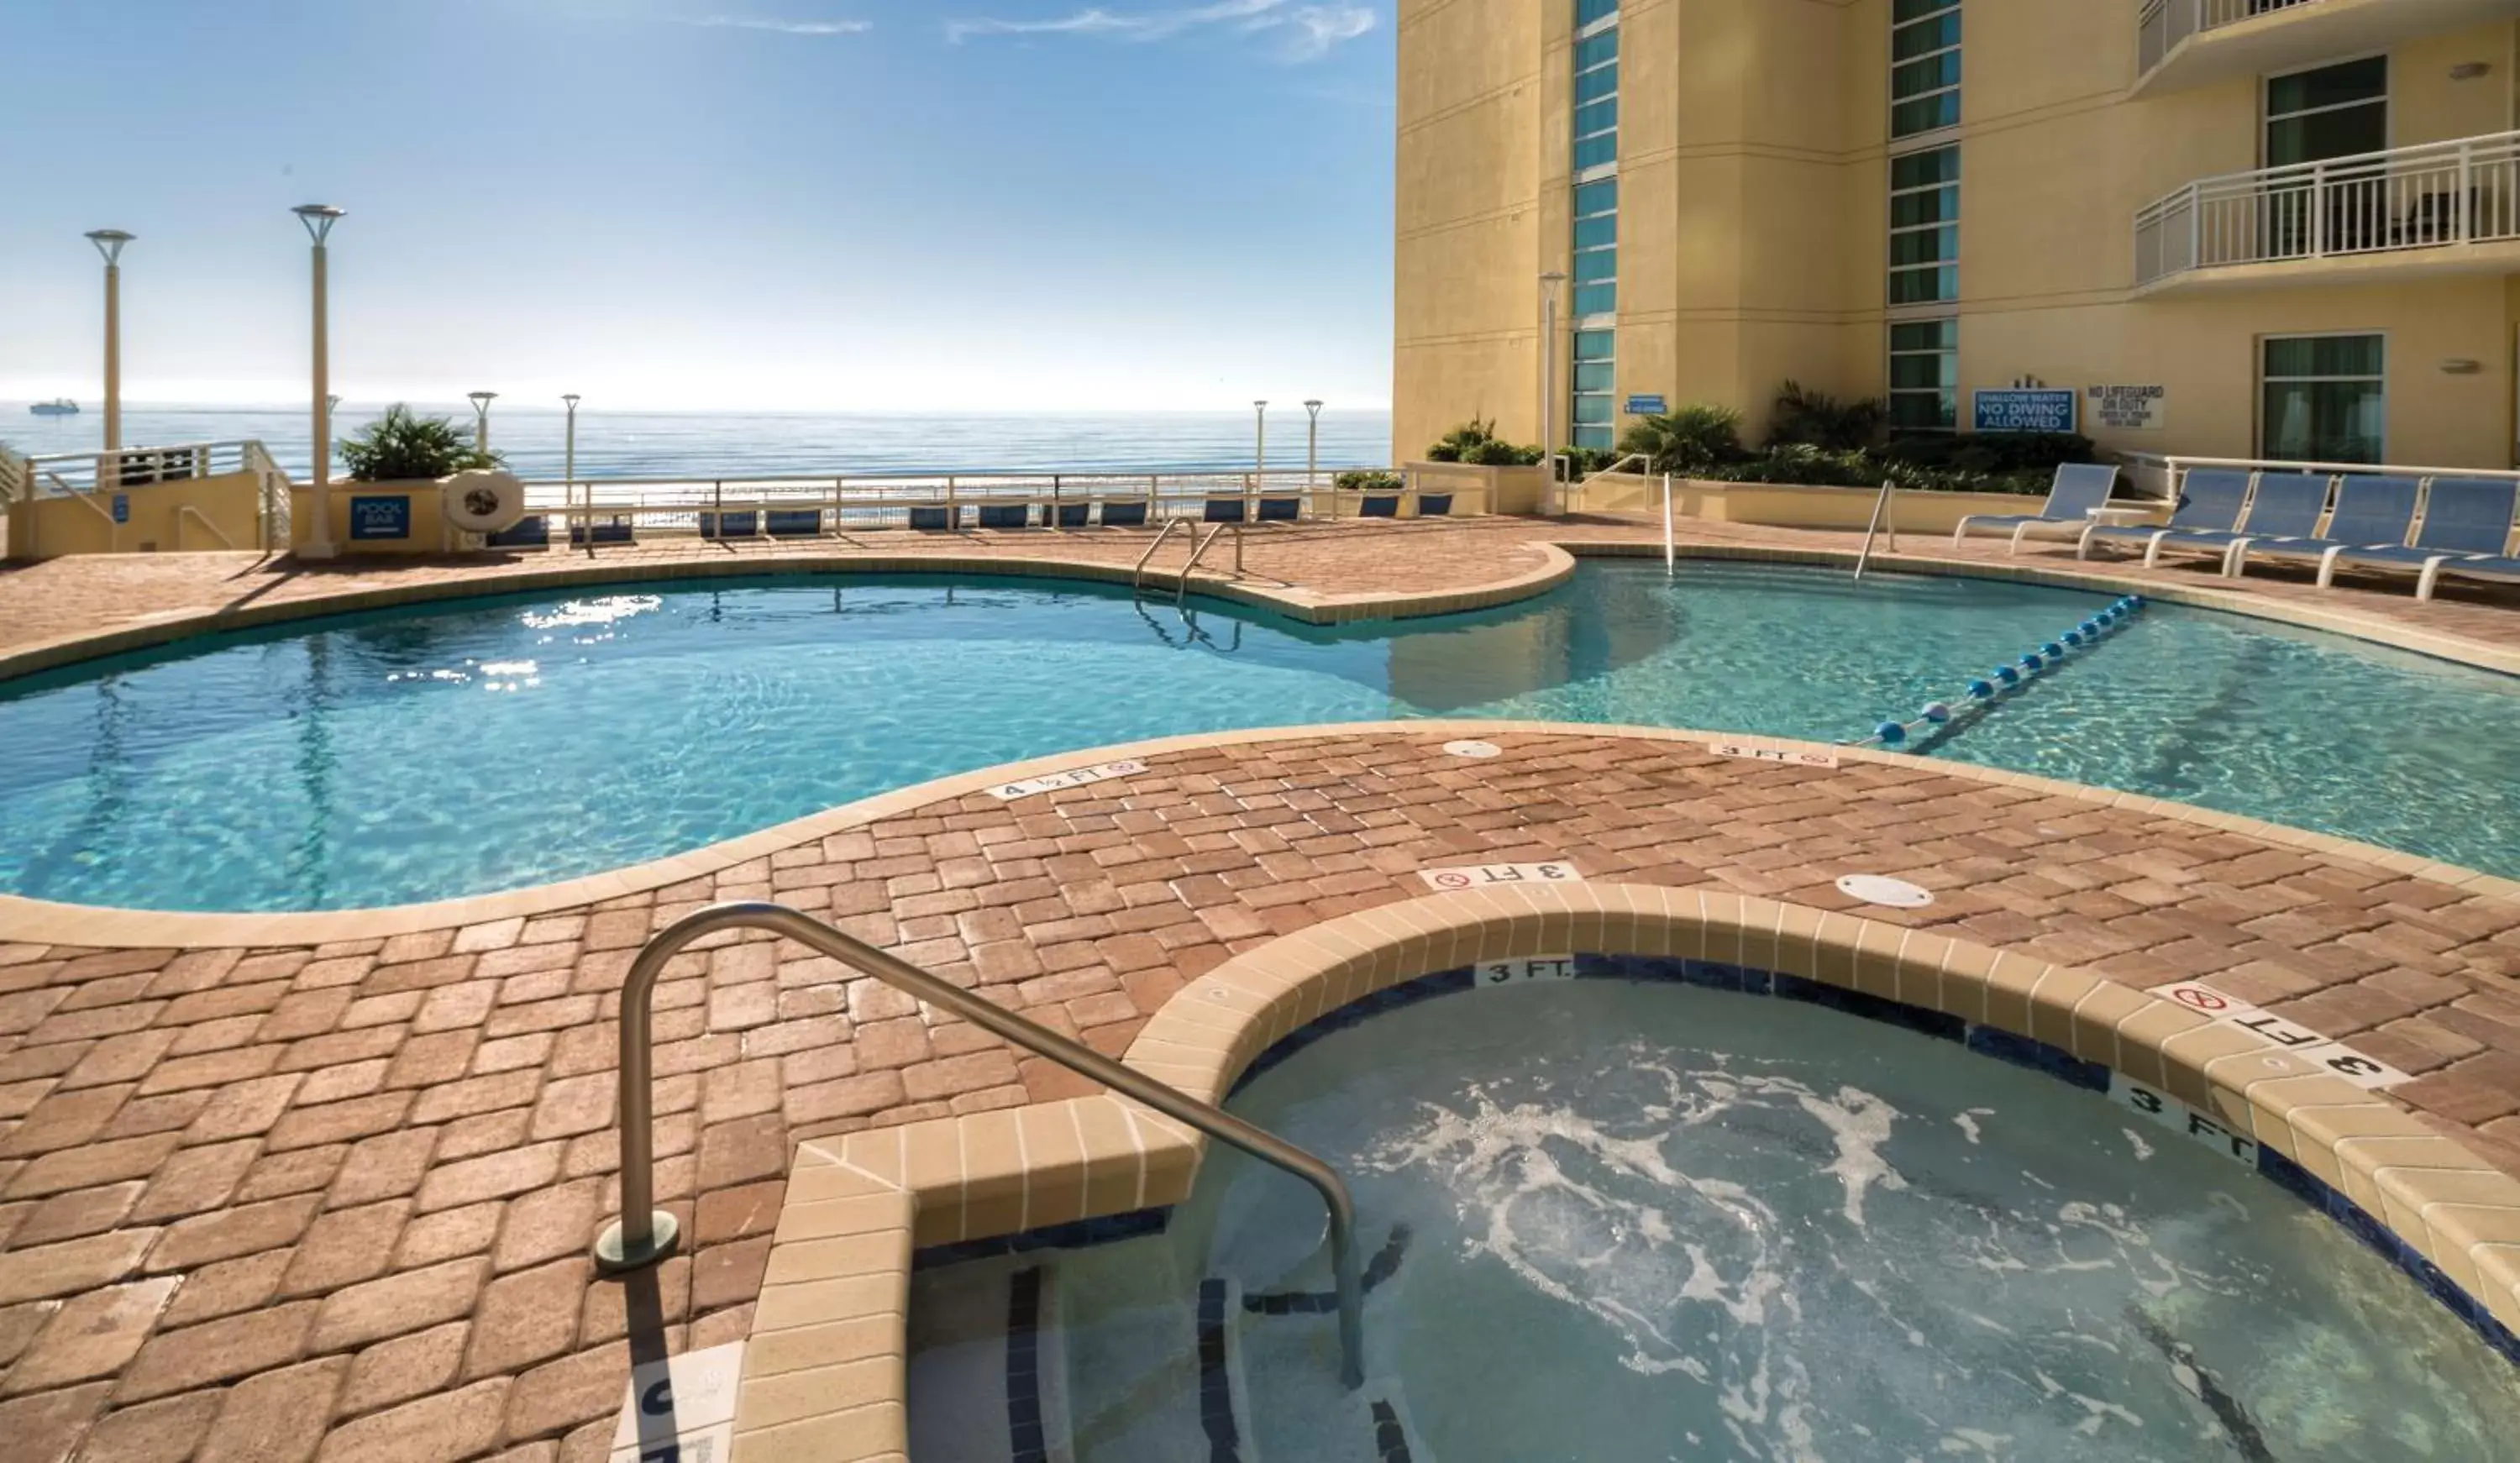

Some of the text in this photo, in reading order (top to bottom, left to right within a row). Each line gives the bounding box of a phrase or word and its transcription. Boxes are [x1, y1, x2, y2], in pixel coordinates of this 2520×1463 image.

[2089, 385, 2164, 399] NO LIFEGUARD
[1978, 403, 2068, 415] NO DIVING
[2118, 397, 2148, 411] DUTY
[1983, 415, 2061, 428] ALLOWED
[356, 502, 402, 515] POOL
[365, 514, 395, 525] BAR
[1482, 864, 1565, 882] 3 FT
[1488, 960, 1572, 983] 3 FT.
[2233, 1018, 2382, 1077] 3 FT
[2130, 1086, 2163, 1115] 3
